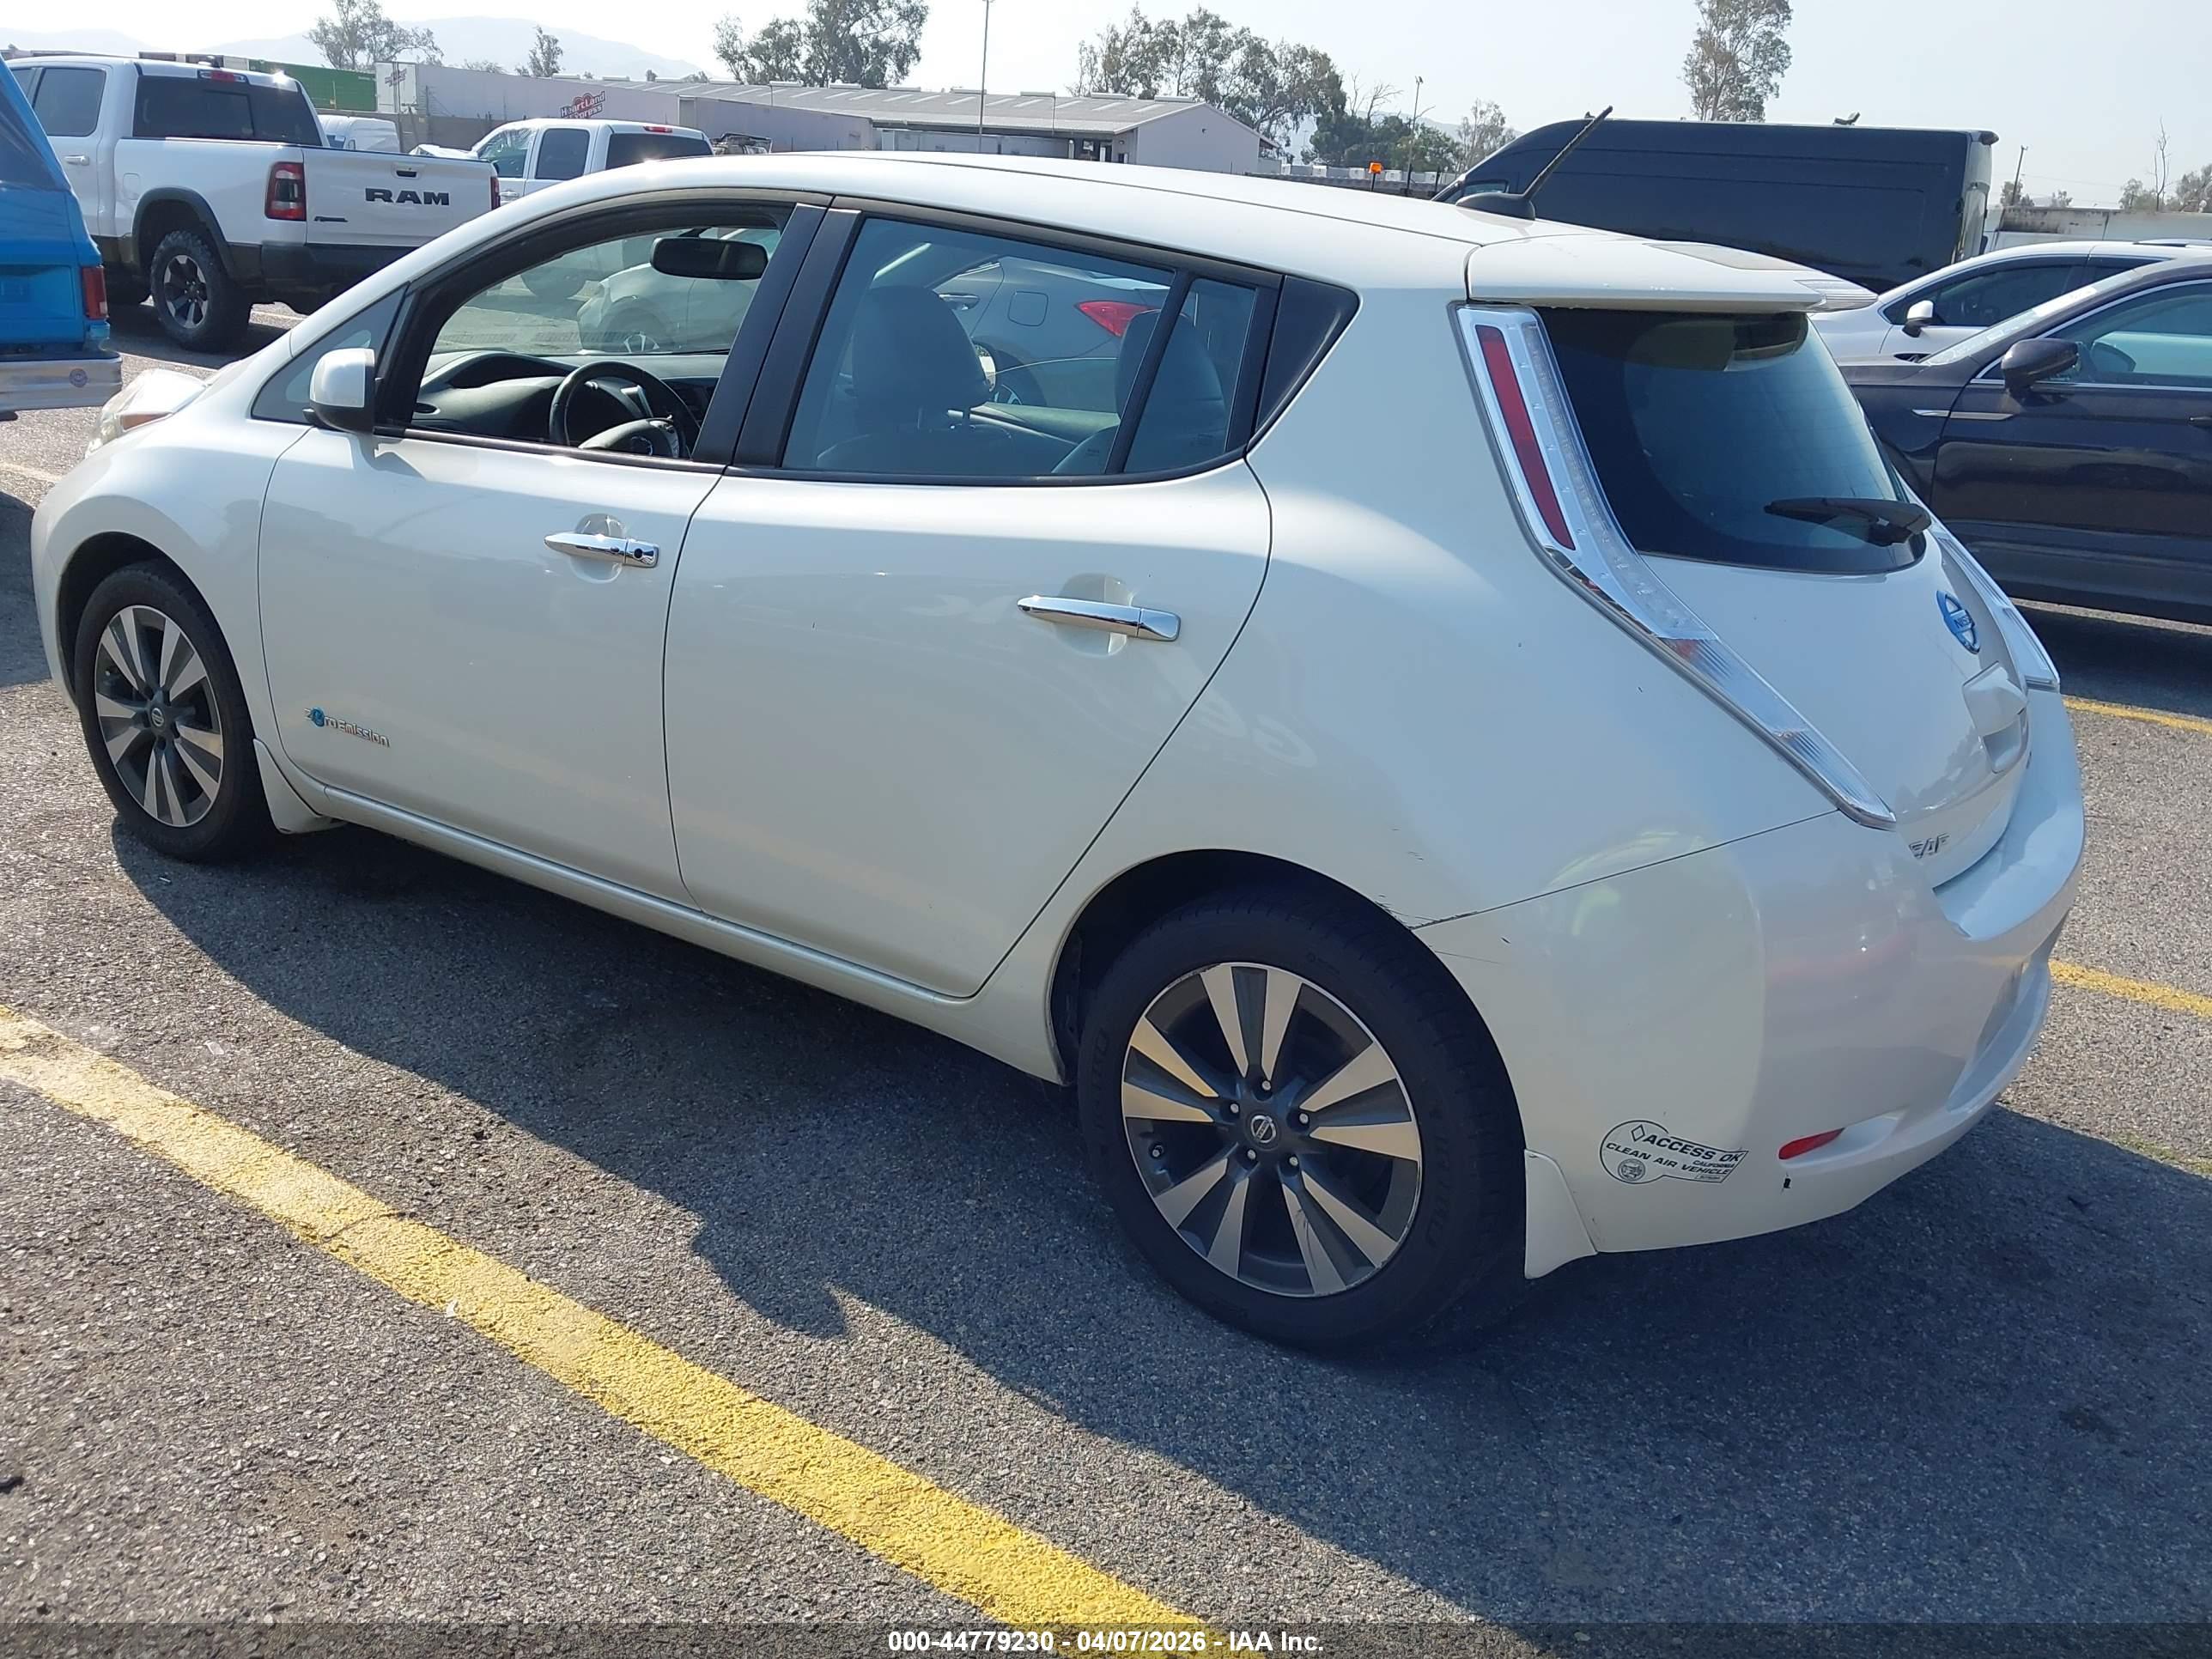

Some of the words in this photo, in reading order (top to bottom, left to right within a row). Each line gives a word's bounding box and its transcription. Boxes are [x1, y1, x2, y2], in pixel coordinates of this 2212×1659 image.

[561, 91, 605, 118] HeartLand
[365, 188, 449, 205] RAM
[1908, 833, 1950, 859] EAF
[1606, 1142, 1651, 1160] CLEAN
[1653, 1157, 1678, 1168] AIR
[1681, 1164, 1732, 1175] VEHICLE
[1642, 1134, 1717, 1160] ACCESS
[1718, 1152, 1743, 1162] OK
